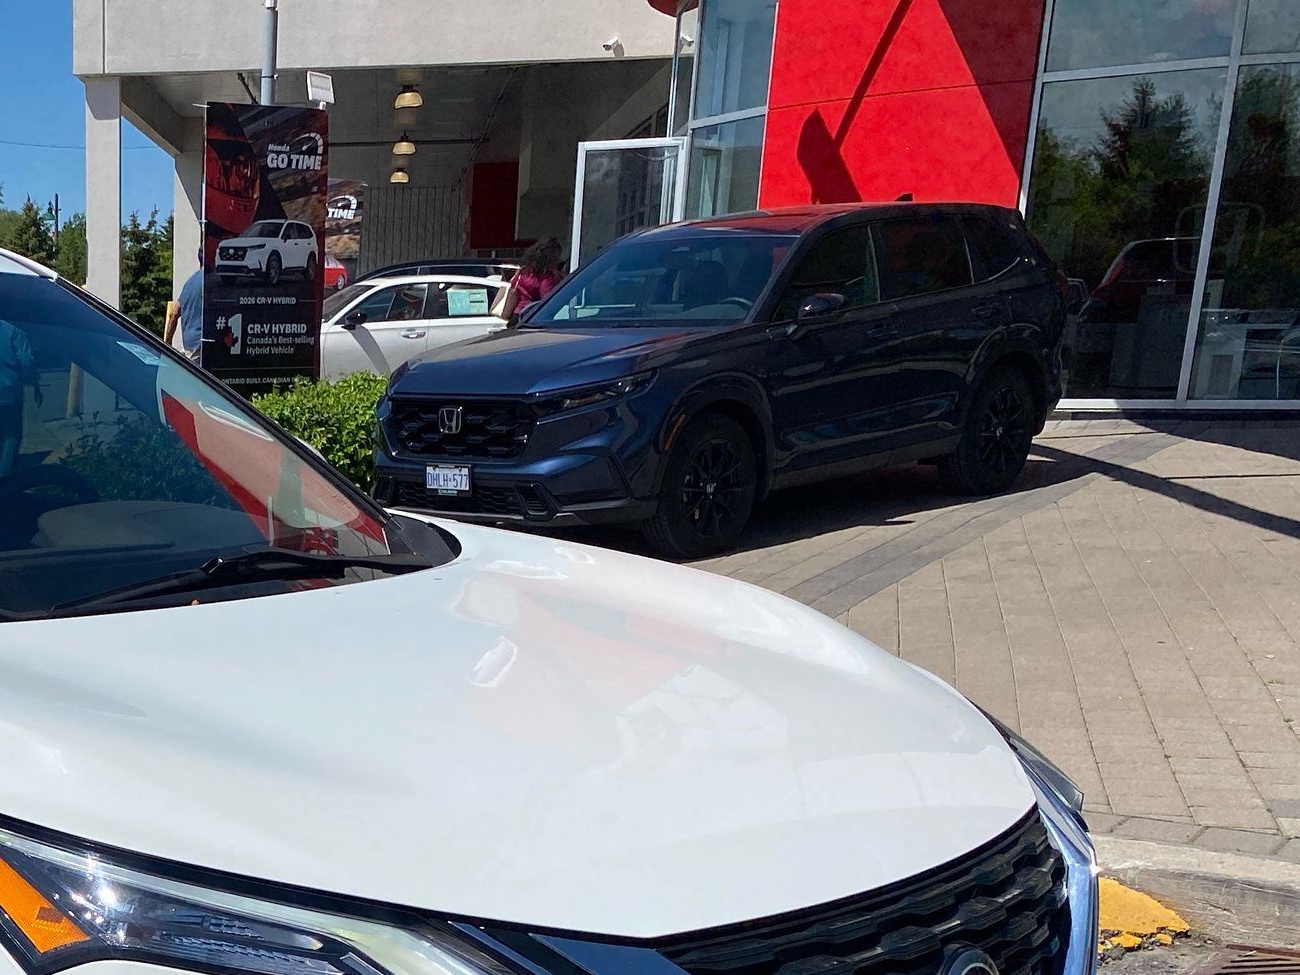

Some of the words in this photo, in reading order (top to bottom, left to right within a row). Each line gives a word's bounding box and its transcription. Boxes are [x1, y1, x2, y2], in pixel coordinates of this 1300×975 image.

[268, 144, 290, 152] Honda
[267, 153, 288, 169] GO
[291, 155, 323, 170] TIME
[327, 209, 356, 219] TIME
[239, 297, 256, 305] 2026
[273, 297, 297, 305] HYBRID
[247, 323, 271, 334] CR-V
[272, 323, 307, 334] HYBRID
[246, 336, 277, 345] Canada's
[278, 335, 315, 346] Best-selling
[246, 345, 270, 356] Hybrid
[270, 345, 295, 354] Vehicle
